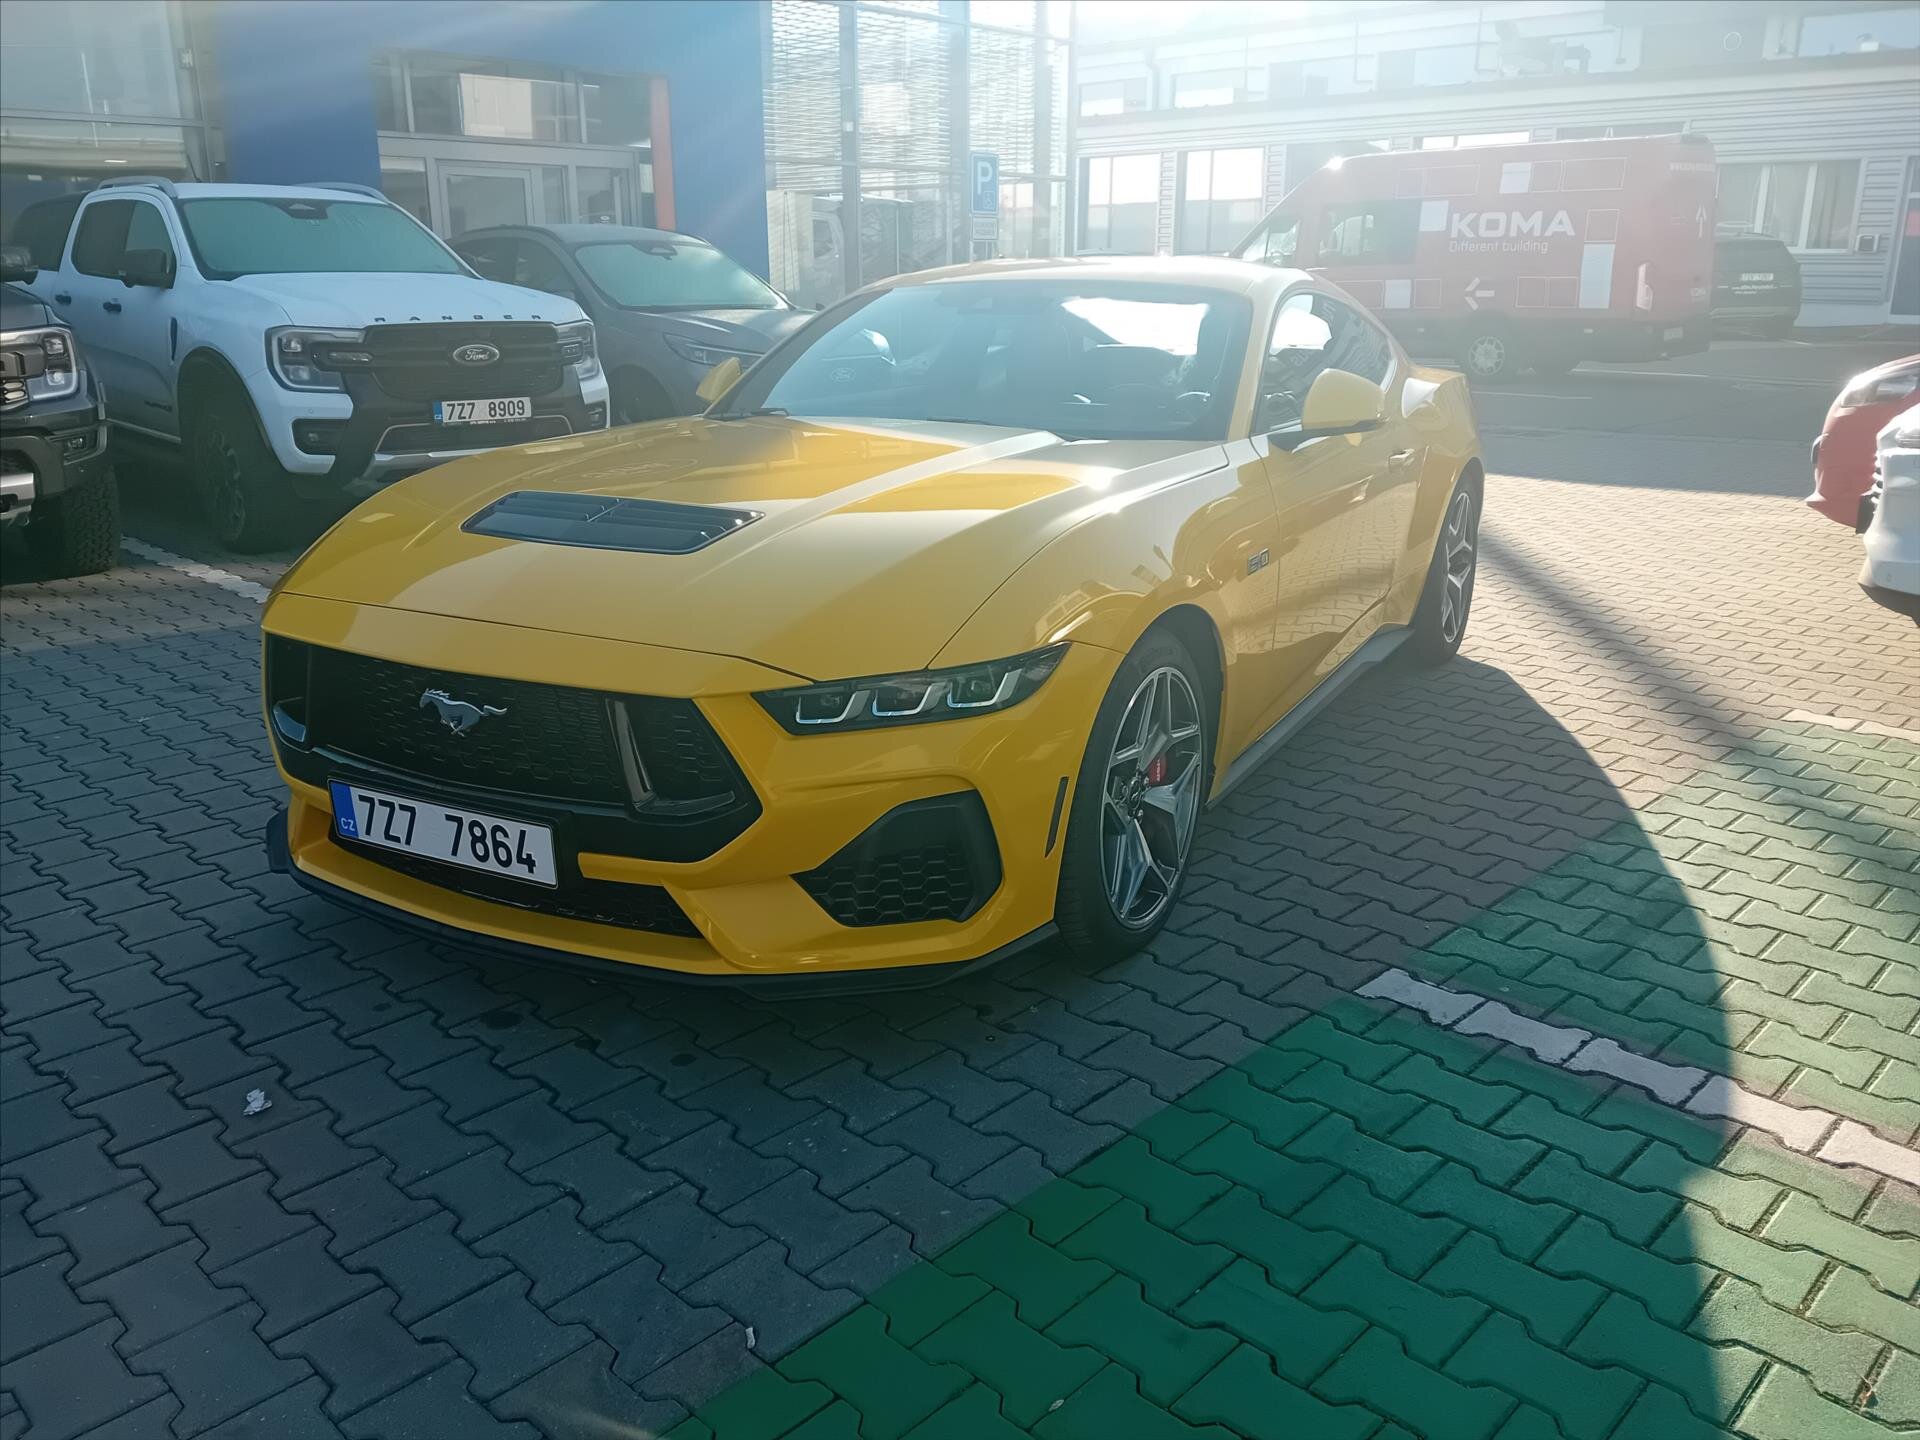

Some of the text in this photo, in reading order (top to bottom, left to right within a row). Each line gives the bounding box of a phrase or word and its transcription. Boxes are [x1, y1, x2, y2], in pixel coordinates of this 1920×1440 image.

[977, 161, 993, 195] P
[1450, 210, 1576, 238] KOMA
[1449, 239, 1549, 255] Different building
[464, 349, 491, 361] Ford
[446, 402, 476, 421] 7Z7
[488, 400, 525, 418] 8909
[340, 794, 537, 874] CZ 7Z7 7864
